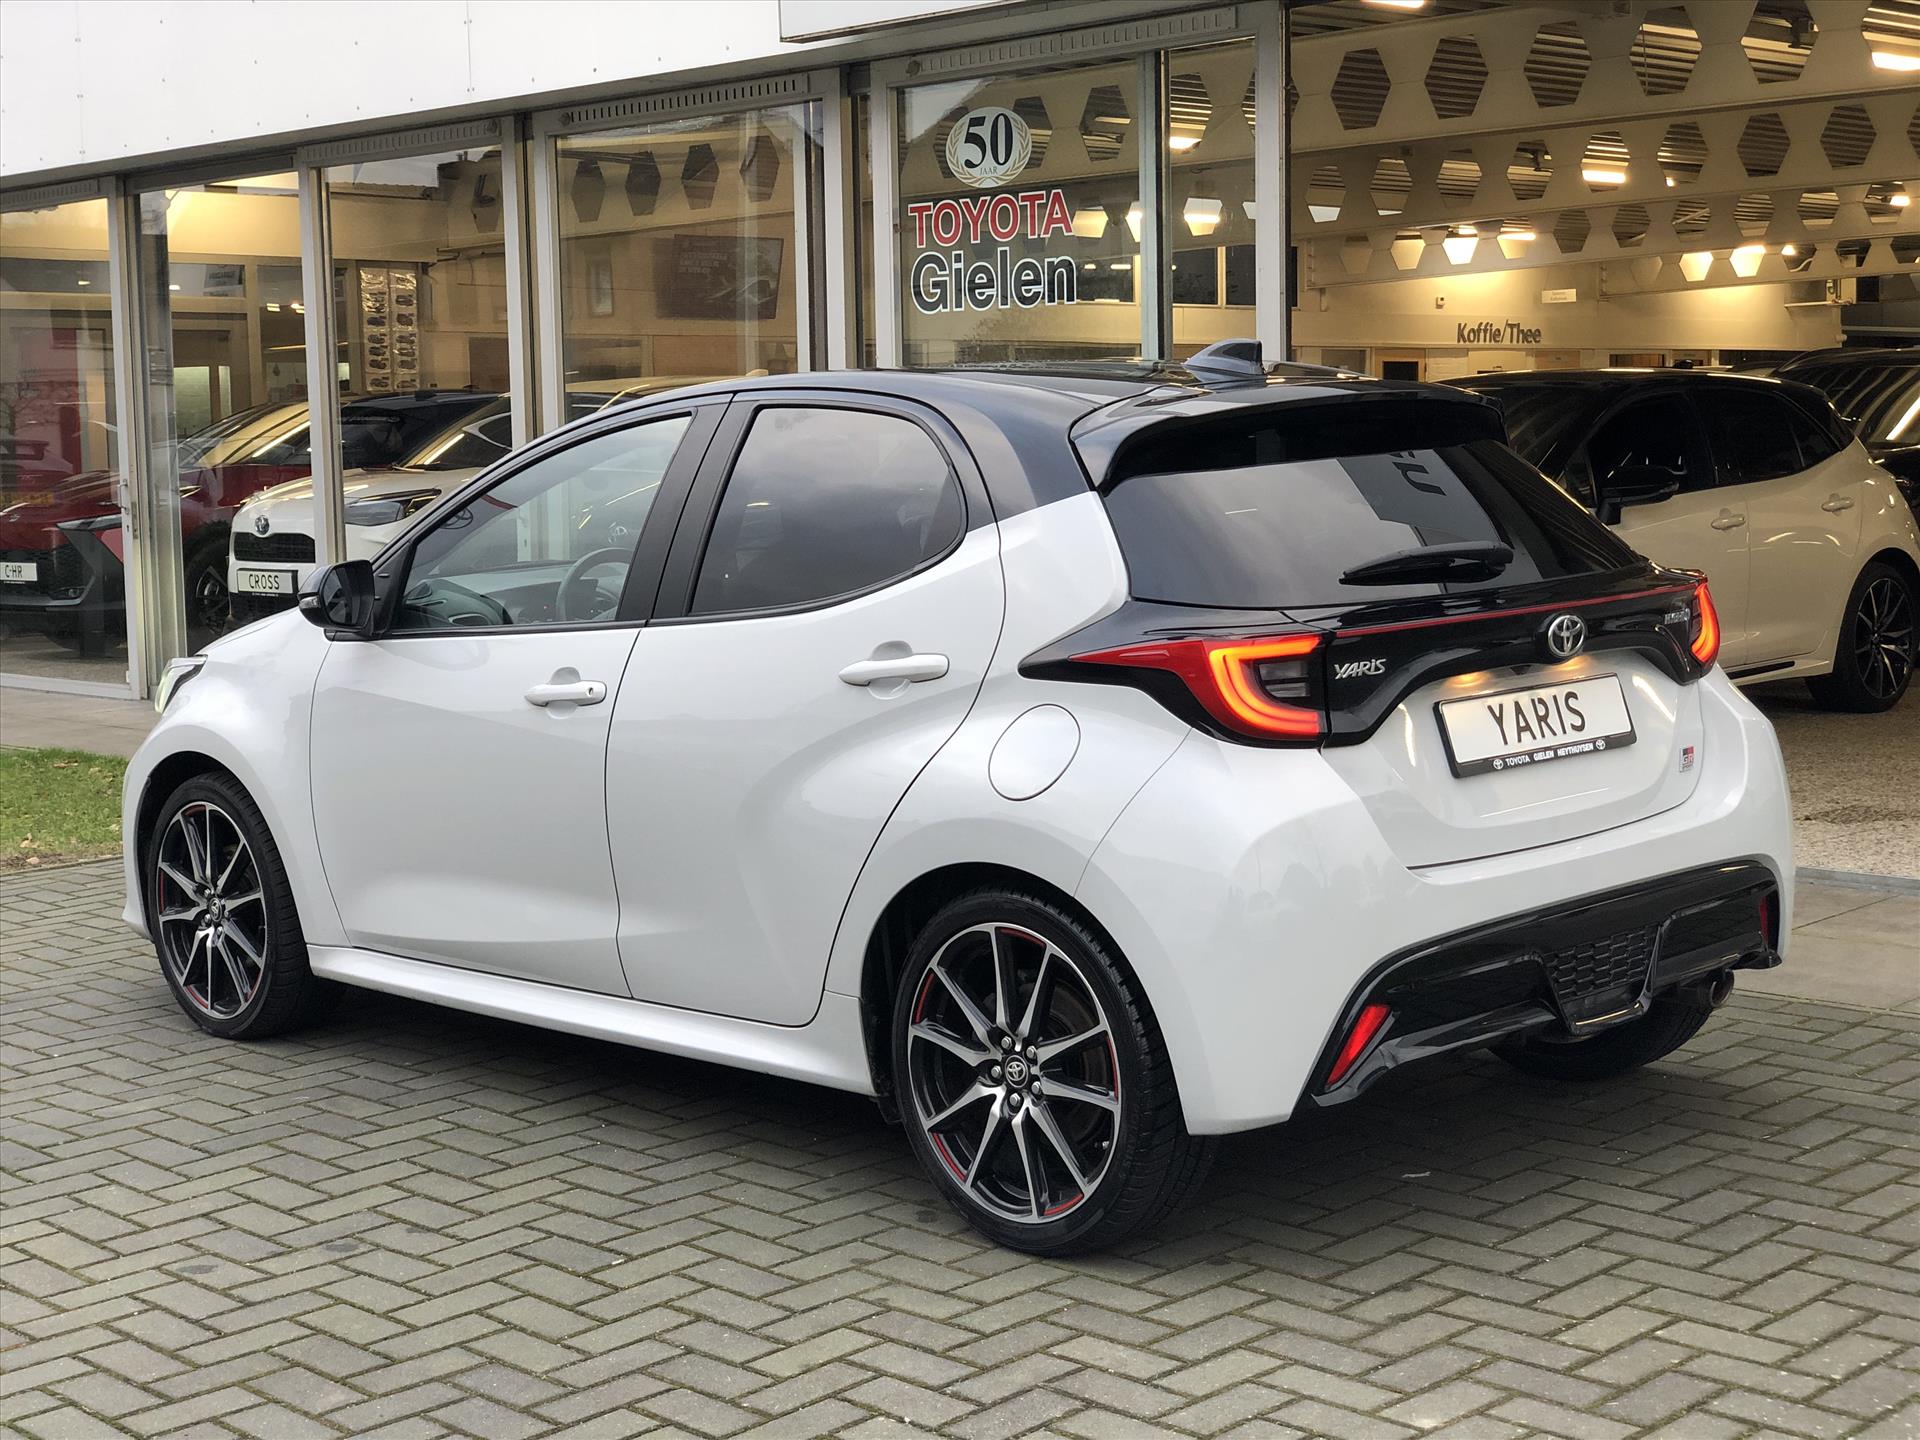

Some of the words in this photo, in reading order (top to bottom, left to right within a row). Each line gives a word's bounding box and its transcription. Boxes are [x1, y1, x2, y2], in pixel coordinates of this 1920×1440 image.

[963, 113, 1014, 169] 50
[980, 166, 998, 175] JAAR
[908, 189, 1073, 248] TOYOTA
[911, 247, 1077, 314] Gielen
[1457, 319, 1542, 343] Koffie/Thee
[4, 564, 23, 578] C-HR
[248, 573, 280, 590] CROSS
[1487, 691, 1586, 746] YARIS
[1505, 755, 1531, 767] TOYOTA
[1533, 750, 1555, 762] GIELEN
[1557, 742, 1594, 757] HEYTHUYSEN
